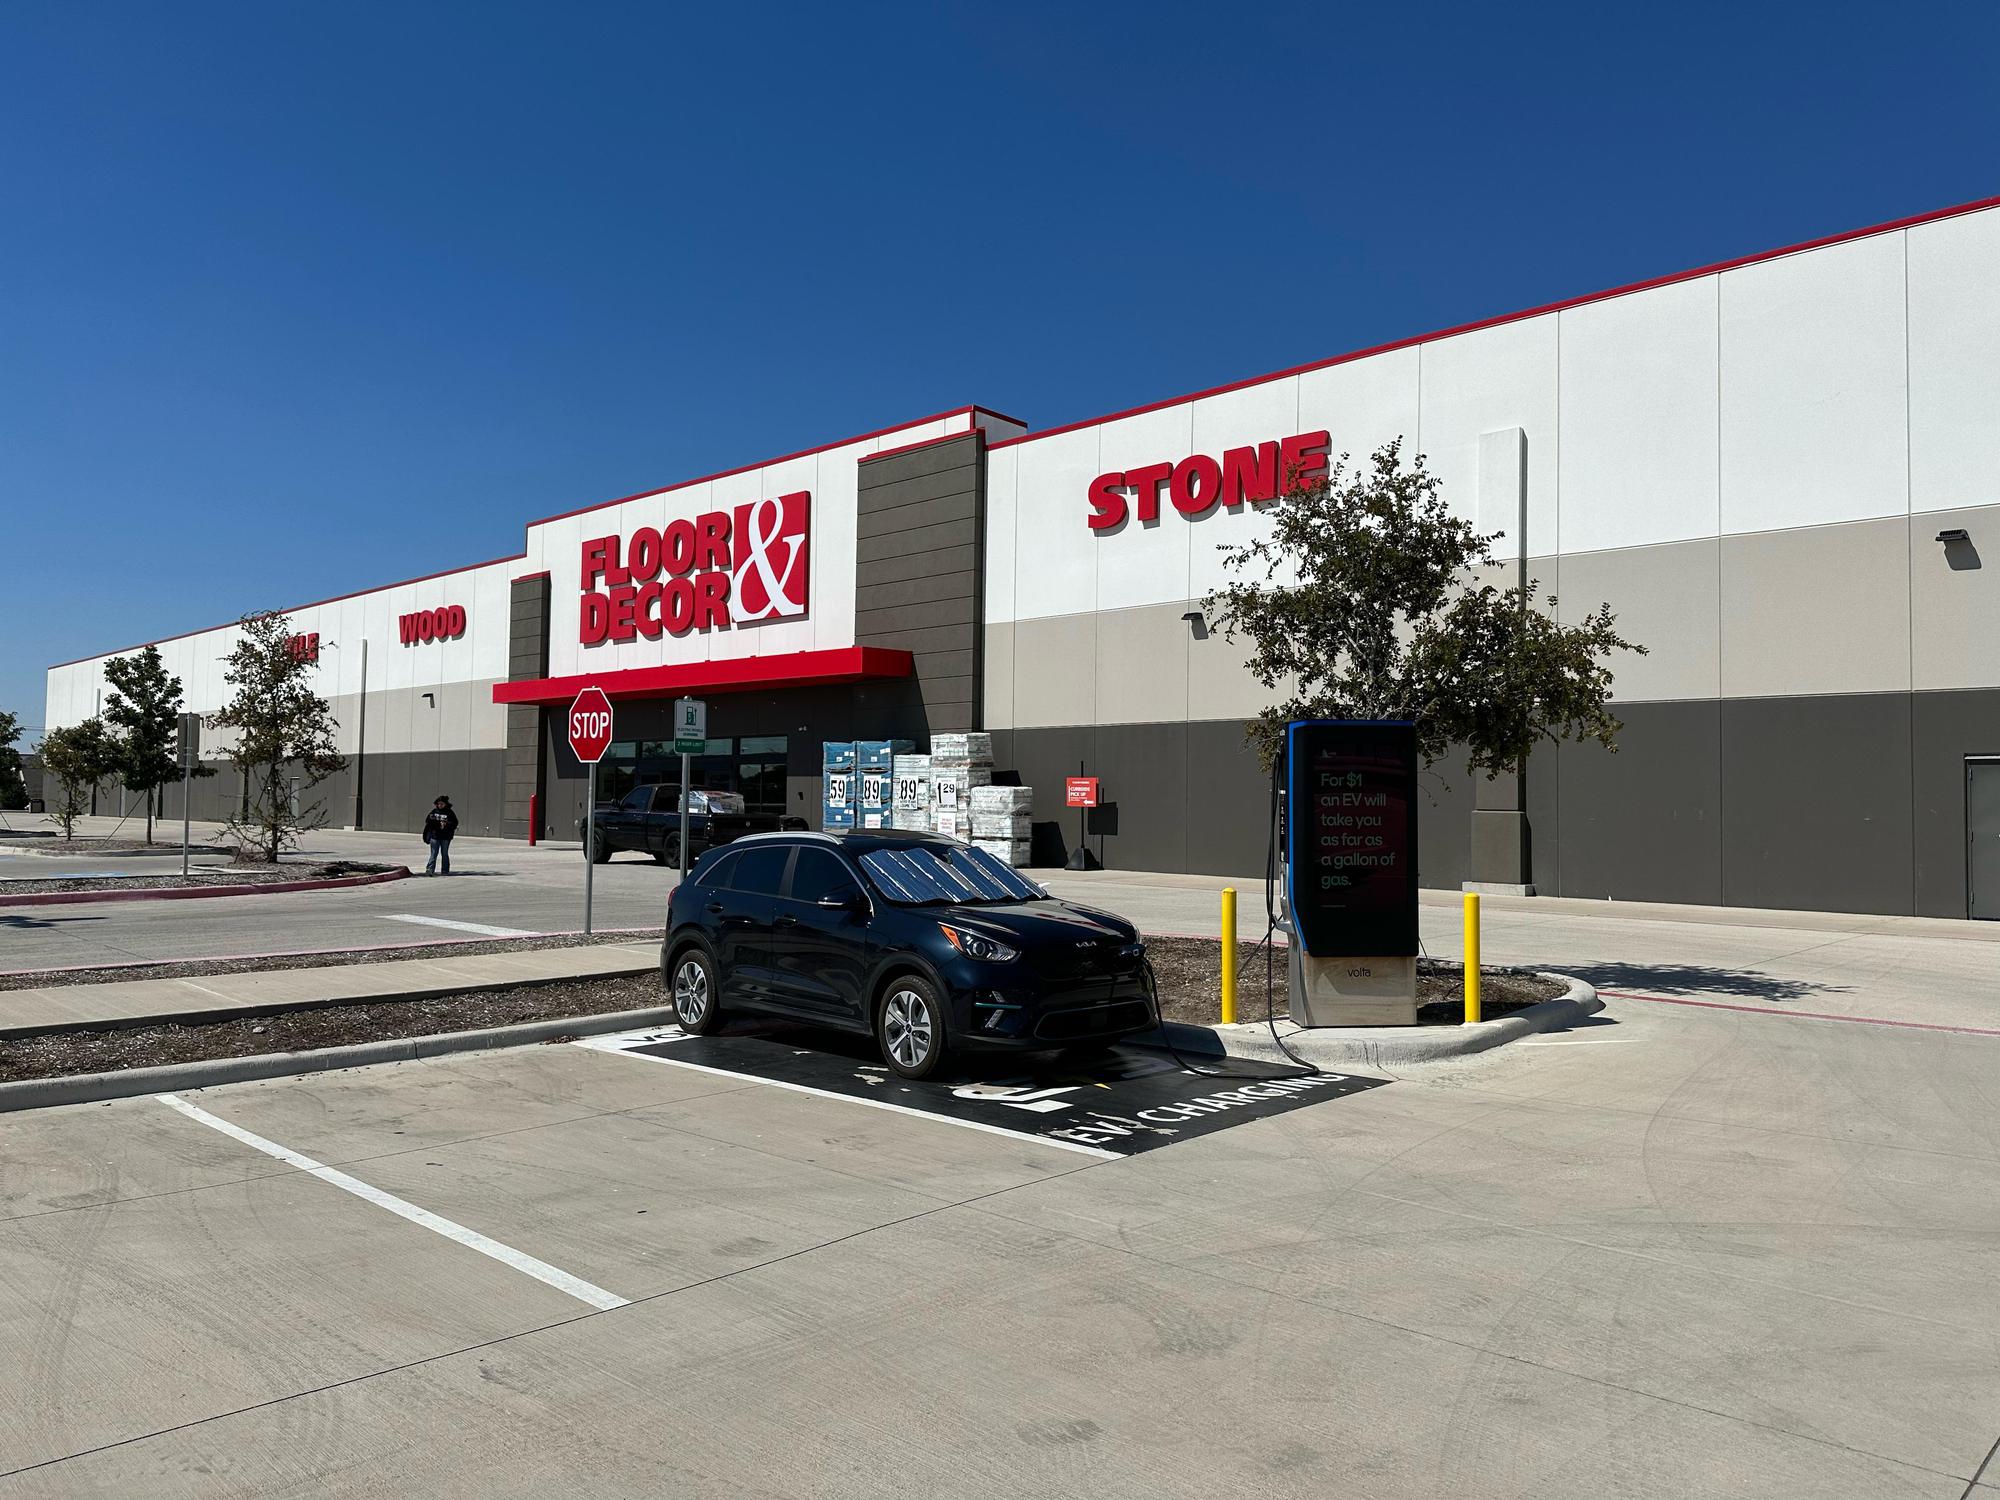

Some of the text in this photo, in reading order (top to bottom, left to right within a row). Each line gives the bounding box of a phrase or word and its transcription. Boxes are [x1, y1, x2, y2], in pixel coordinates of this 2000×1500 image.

[1088, 430, 1331, 529] STONE
[580, 497, 806, 623] FLOOR &
[579, 571, 732, 645] DECOR
[398, 605, 466, 644] WOOD
[572, 711, 609, 739] STOP
[830, 779, 845, 799] 59
[864, 779, 880, 800] 89
[1321, 771, 1362, 789] For $1
[1321, 793, 1386, 807] an EV will
[1321, 813, 1382, 829] take you
[1321, 832, 1383, 846] as far as
[1321, 852, 1396, 869] a gallon of
[1321, 875, 1352, 890] gas.
[1347, 967, 1371, 977] volta
[1137, 1073, 1351, 1122] CHARGING
